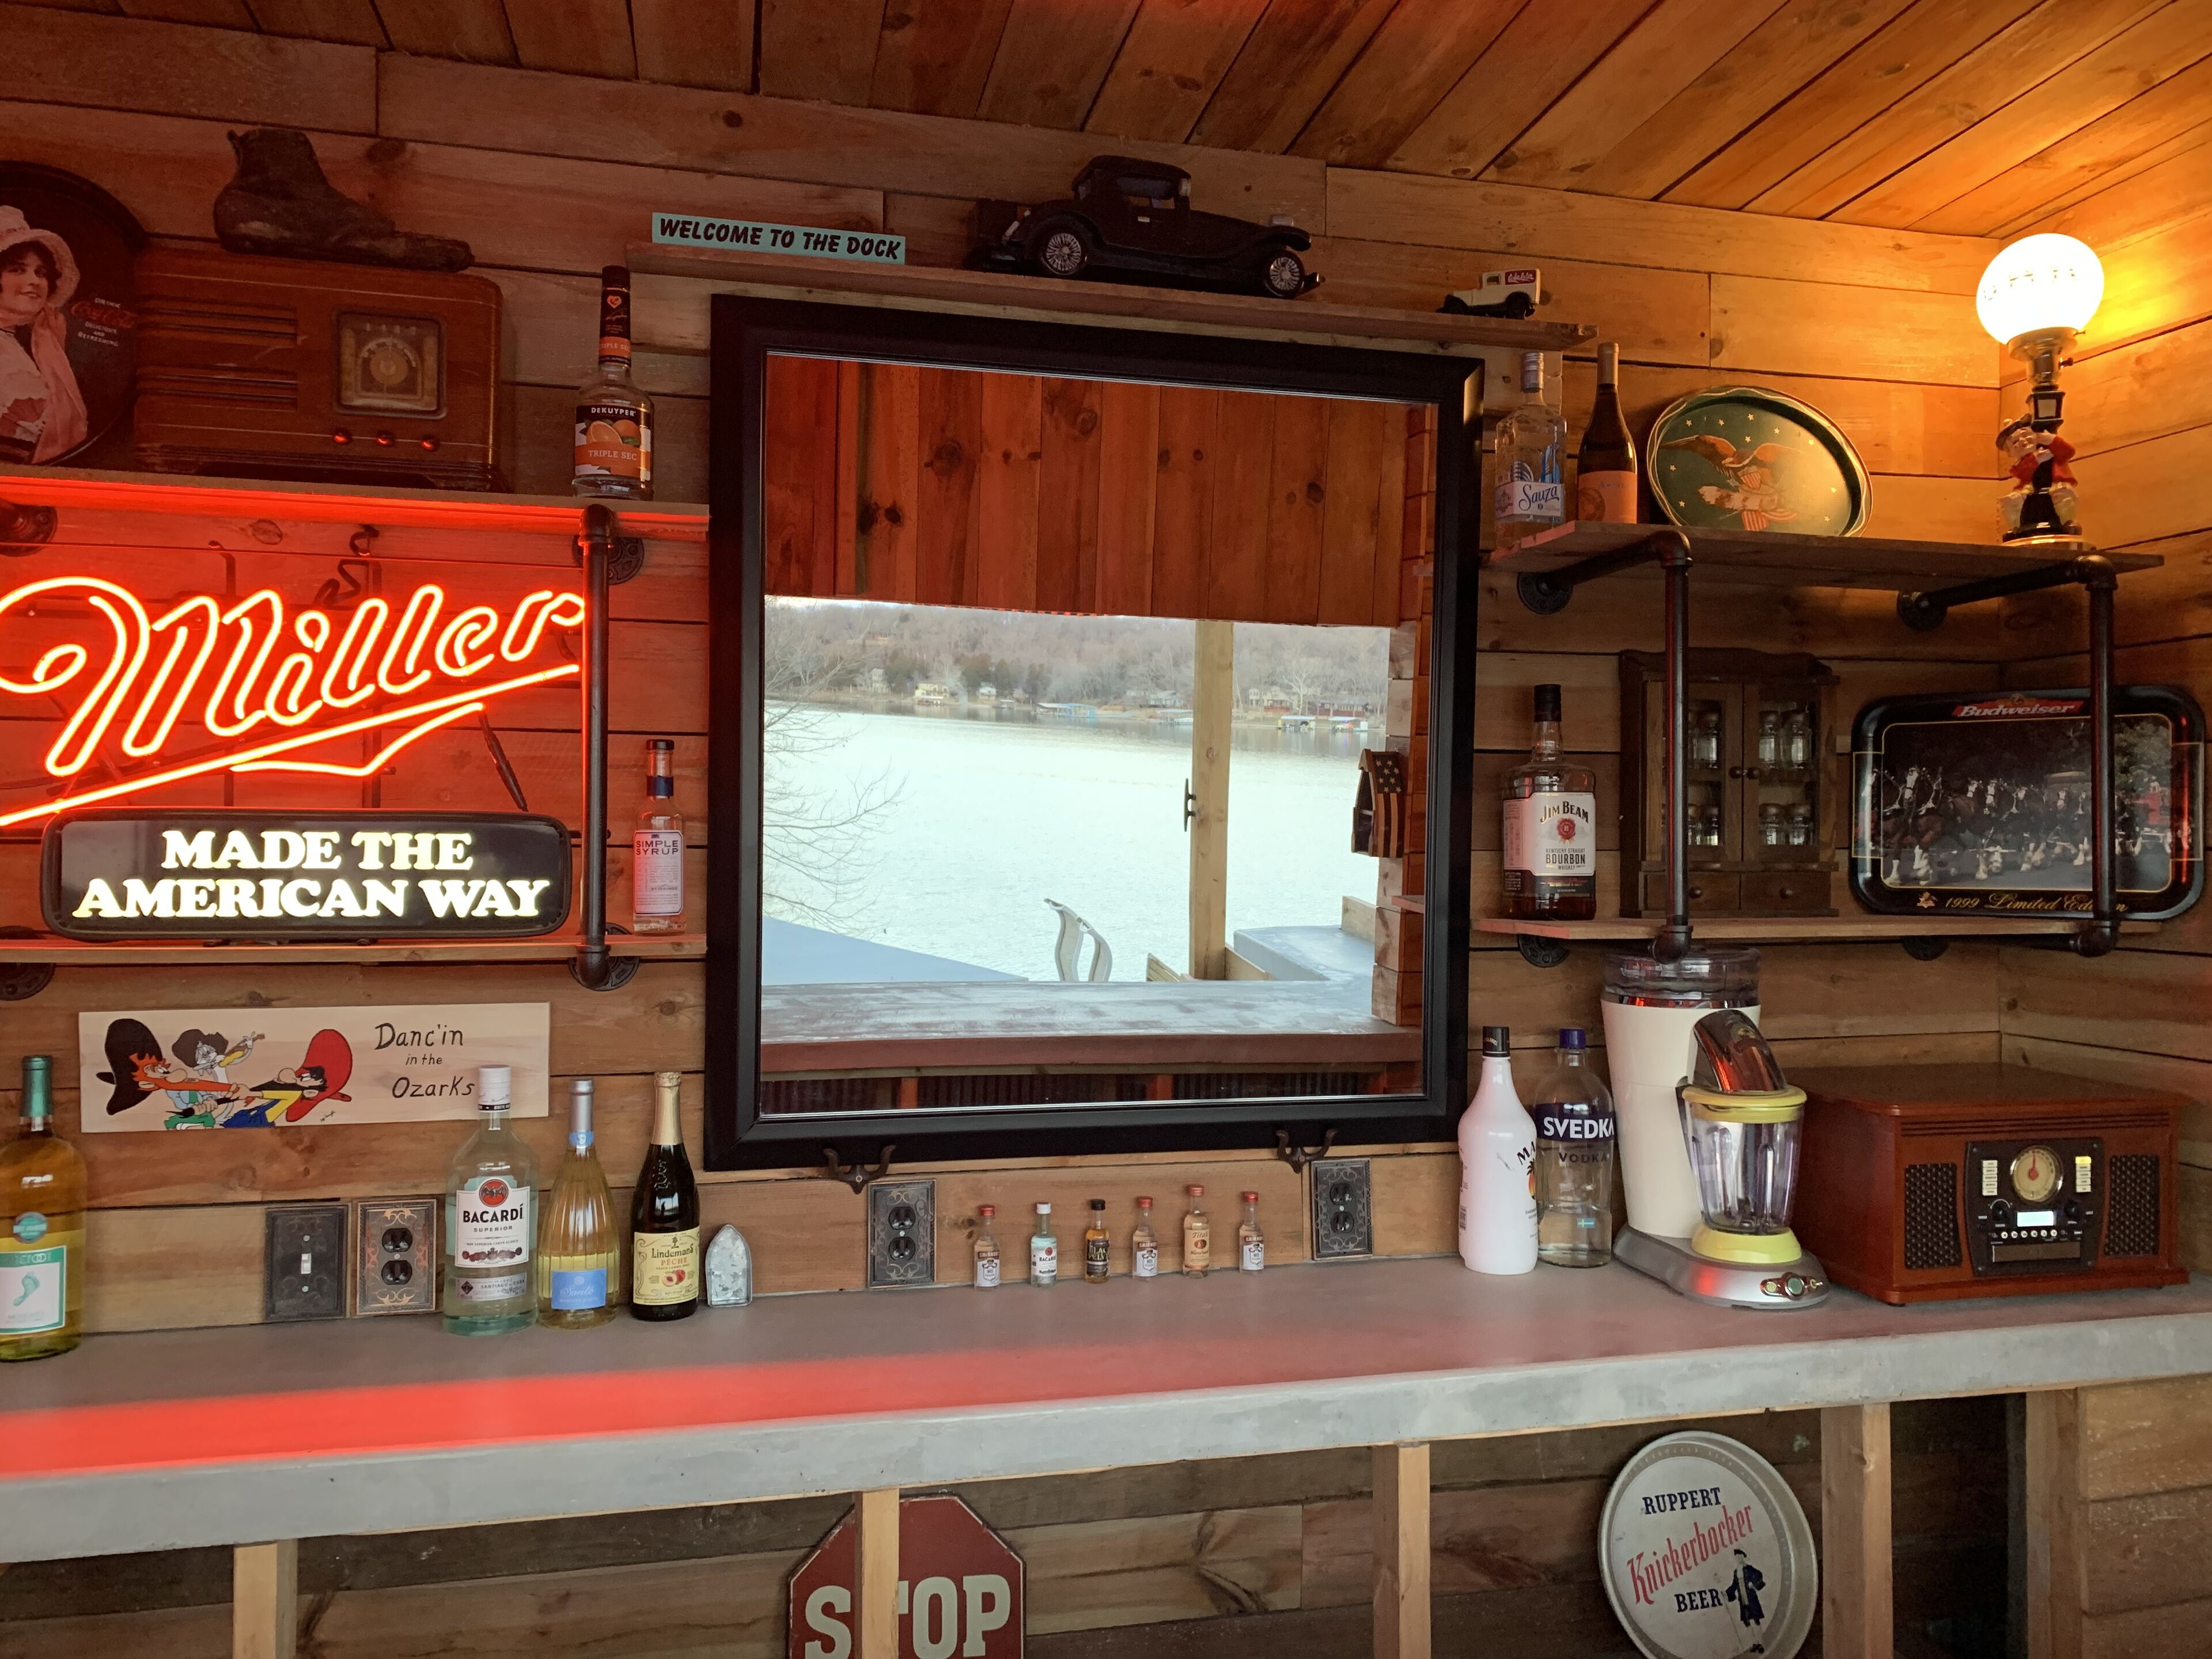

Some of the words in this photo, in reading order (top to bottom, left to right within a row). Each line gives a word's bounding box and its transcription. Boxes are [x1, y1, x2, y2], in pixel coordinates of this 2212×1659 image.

[660, 218, 763, 245] WELCOME
[770, 229, 795, 248] TO
[802, 232, 841, 252] THE
[846, 236, 901, 260] DOCK
[588, 450, 618, 458] TRIPLE
[621, 451, 637, 461] SEC
[1518, 484, 1559, 512] Sauza
[0, 575, 586, 777] Miller
[1958, 703, 2075, 717] Budweiser
[1540, 804, 1560, 824] JIM
[1563, 801, 1589, 824] BEAM
[161, 830, 343, 870] MADE
[350, 830, 474, 871] THE
[636, 840, 679, 848] SIMPLE
[1546, 854, 1585, 864] BOURBON
[71, 877, 410, 919] AMERICAN
[417, 878, 551, 919] WAY
[1945, 897, 1980, 909] 1999
[1984, 892, 2062, 910] Limited
[374, 1022, 464, 1050] Danc'in
[406, 1054, 418, 1066] in
[422, 1053, 443, 1065] the
[1543, 1117, 1614, 1139] SVEDKA
[1558, 1152, 1608, 1163] VODKA
[463, 1203, 524, 1223] BACARDÍ
[651, 1243, 694, 1259] Lindemans
[1642, 1487, 1722, 1515] RUPPERT
[1626, 1505, 1754, 1605] Knickerbocker
[1673, 1588, 1724, 1613] BEER
[804, 1574, 1011, 1659] SOP
